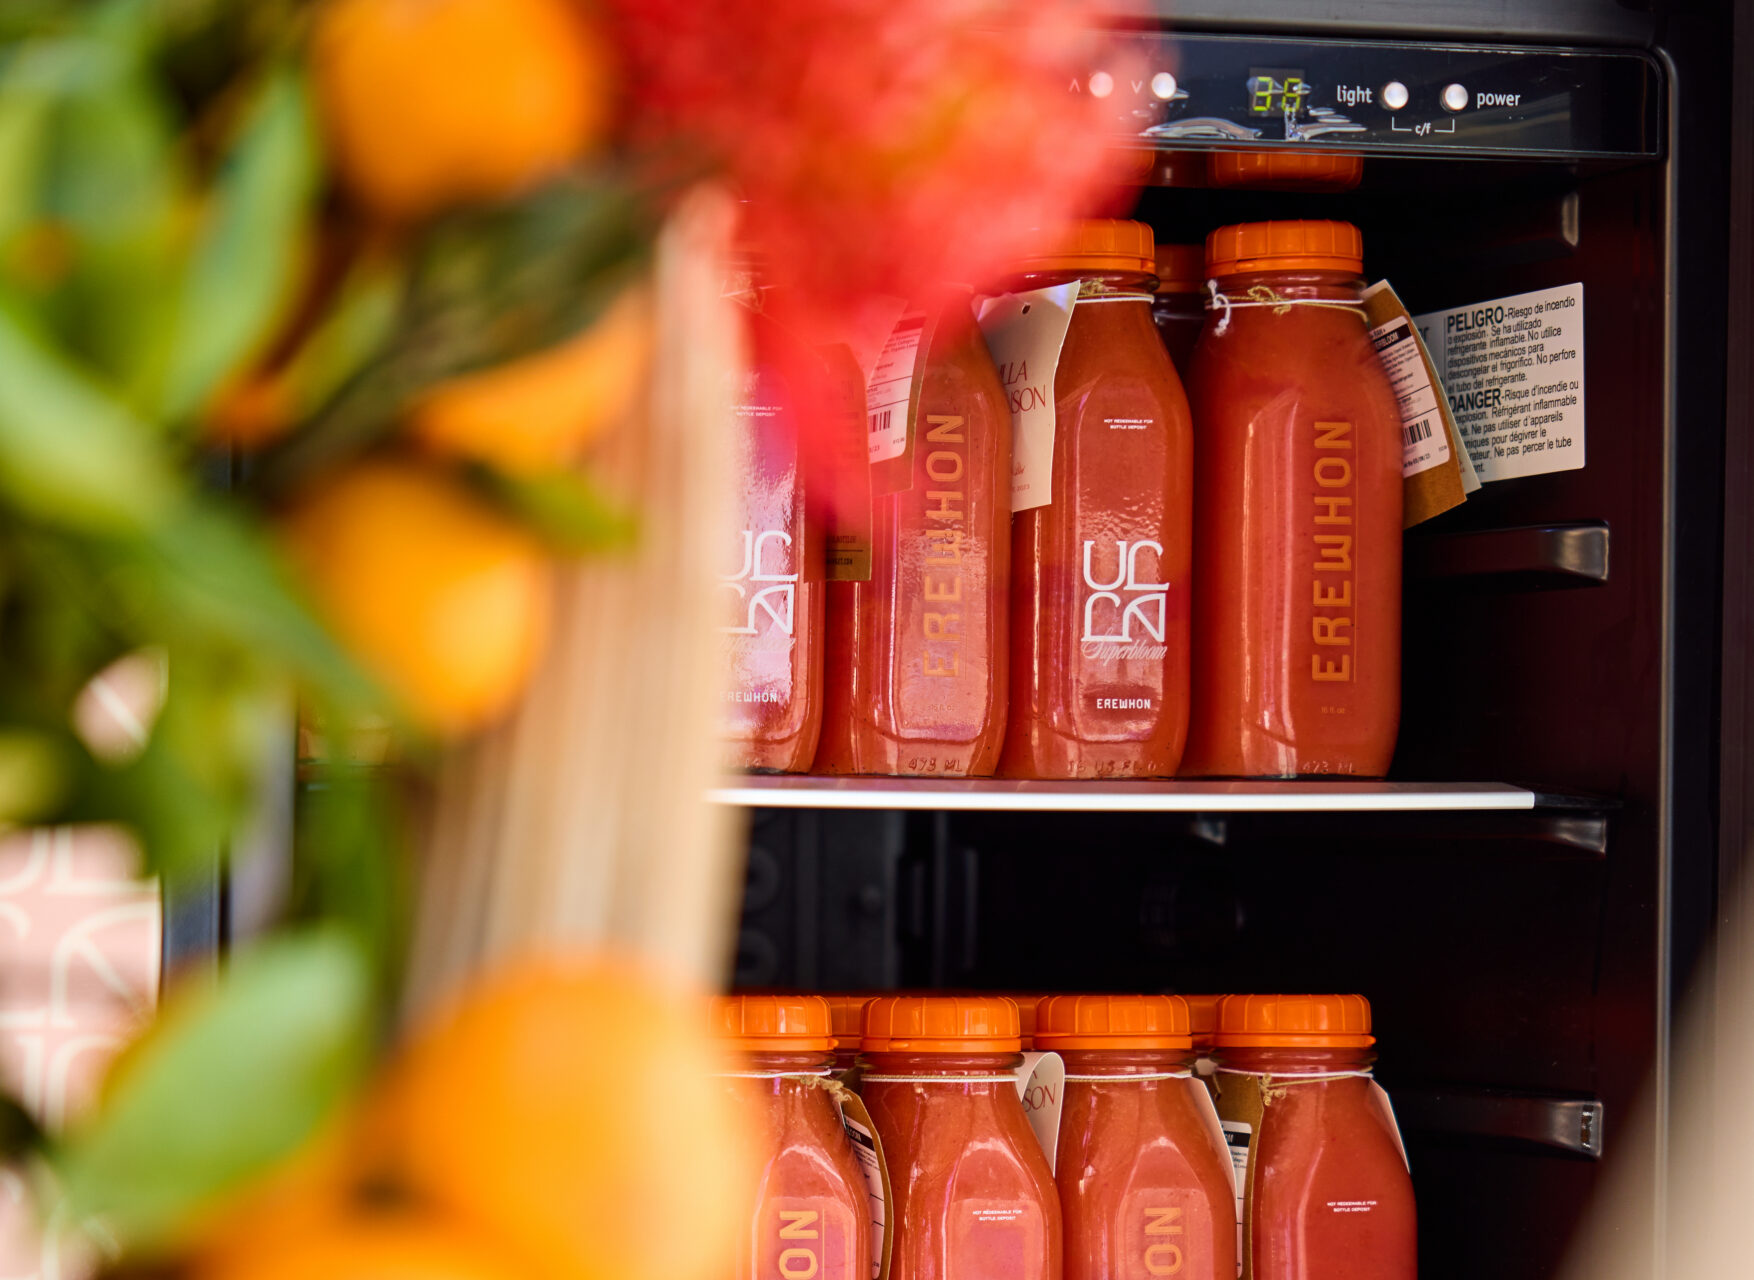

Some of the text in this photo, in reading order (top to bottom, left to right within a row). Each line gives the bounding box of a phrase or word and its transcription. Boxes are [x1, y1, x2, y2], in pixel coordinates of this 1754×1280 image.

[1336, 86, 1373, 106] light
[1476, 91, 1521, 107] power
[1534, 302, 1544, 314] de
[1545, 296, 1575, 310] incendio
[1491, 325, 1501, 337] Se
[1502, 324, 1512, 334] ha
[1513, 318, 1542, 332] utilizado
[1528, 330, 1539, 341] No
[1541, 326, 1562, 340] utilice
[1528, 343, 1544, 356] para
[1492, 361, 1498, 373] el
[1537, 354, 1548, 365] No
[1550, 348, 1576, 363] perfore
[1456, 381, 1472, 393] tubo
[1473, 378, 1484, 390] del
[1570, 380, 1579, 391] ou
[1533, 395, 1577, 411] inflammable
[1471, 424, 1482, 435] Ne
[1484, 423, 1496, 436] pas
[1498, 417, 1521, 431] utiliser
[1491, 435, 1508, 449] pour
[1509, 430, 1538, 444] dégivrer
[1539, 427, 1547, 438] le
[1494, 446, 1505, 458] Ne
[1506, 446, 1520, 459] pas
[1522, 442, 1545, 456] percer
[1546, 439, 1554, 450] le
[1556, 436, 1572, 449] tube
[923, 414, 964, 678] EREWHON
[1312, 421, 1352, 682] EREWHON
[1081, 628, 1168, 667] Superbloom
[1096, 698, 1151, 709] EREWHON
